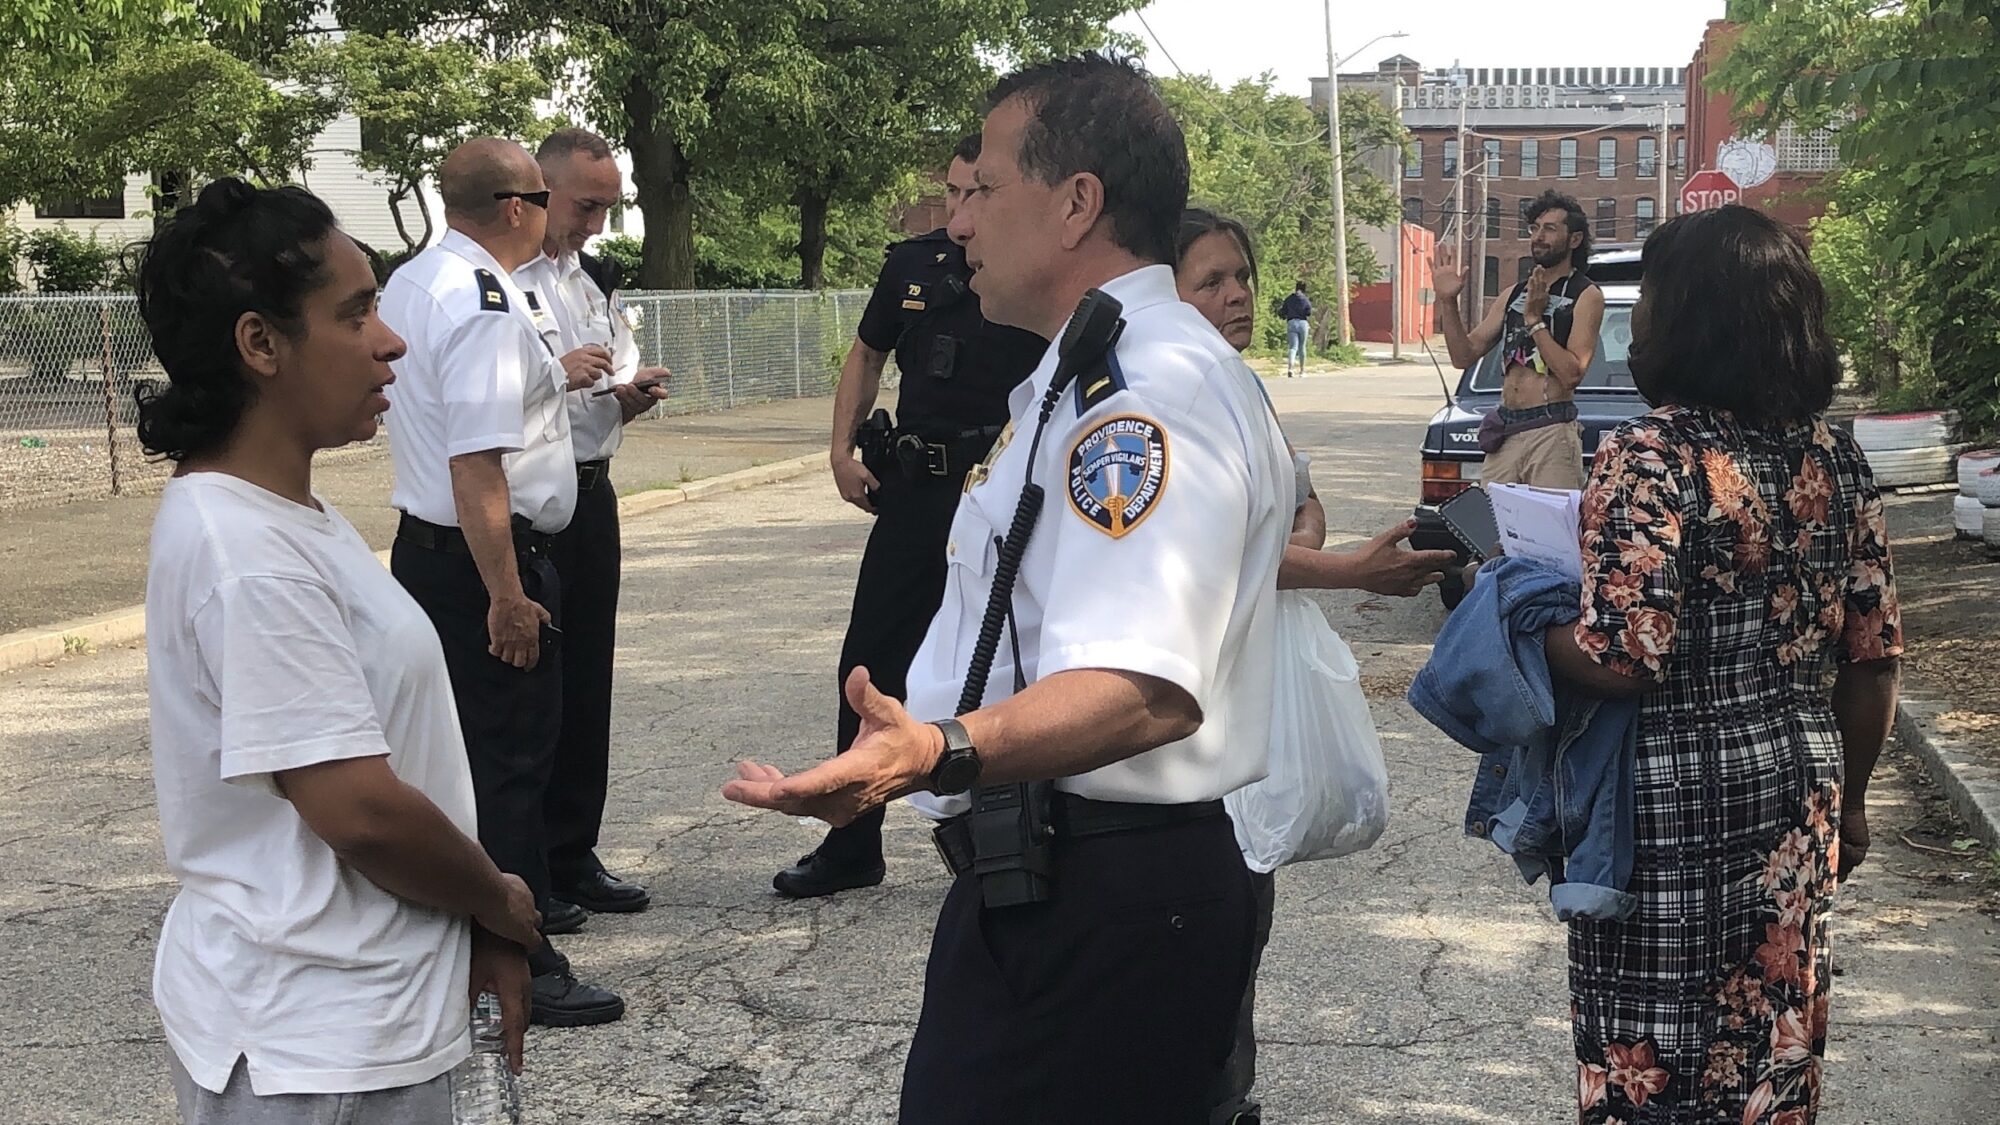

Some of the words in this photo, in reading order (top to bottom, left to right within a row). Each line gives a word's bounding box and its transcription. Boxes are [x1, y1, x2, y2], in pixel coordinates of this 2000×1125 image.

[1685, 190, 1737, 214] STOP
[908, 284, 921, 296] 79
[1077, 420, 1154, 456] PROVIDENCE
[1449, 433, 1479, 442] VOL
[1083, 455, 1111, 478] SEMPER
[1072, 465, 1102, 517] POLICE
[1124, 441, 1163, 519] DEPARTMENT
